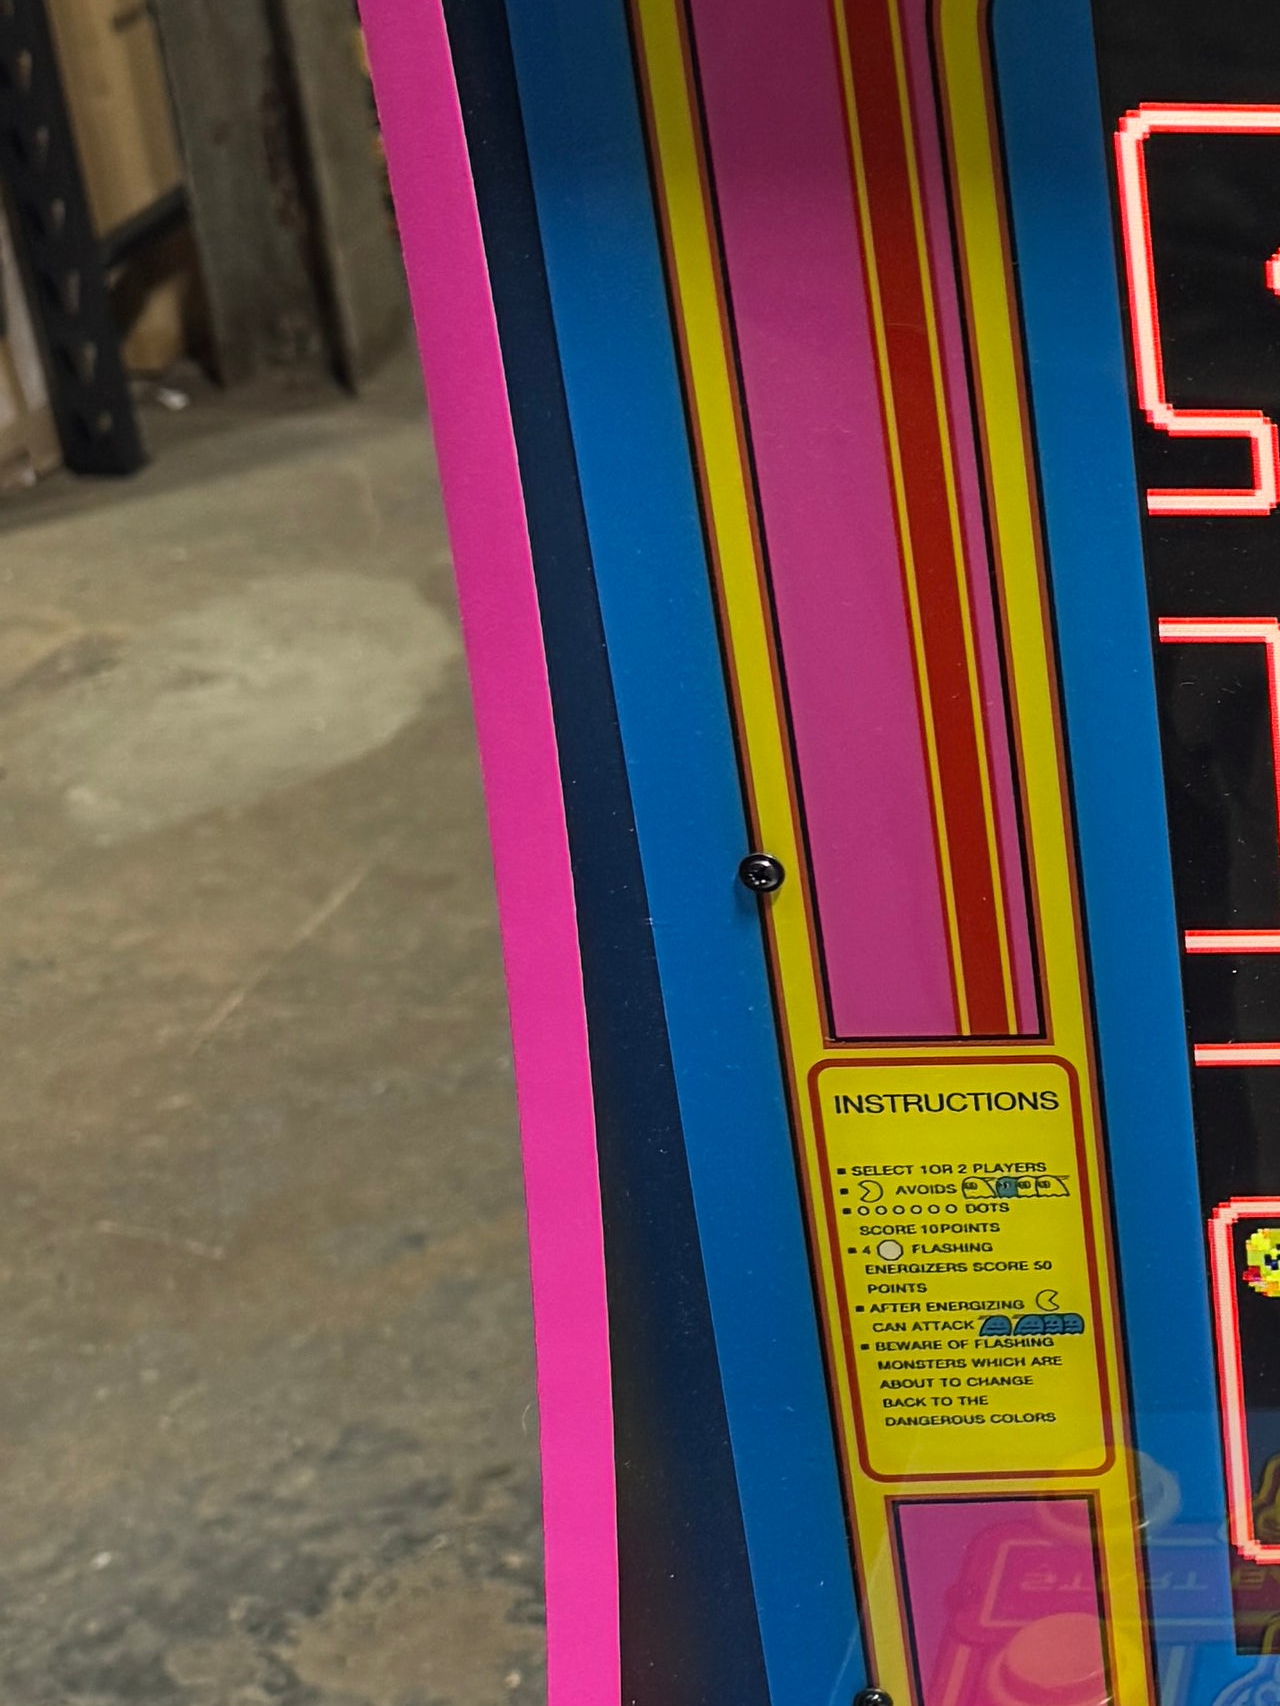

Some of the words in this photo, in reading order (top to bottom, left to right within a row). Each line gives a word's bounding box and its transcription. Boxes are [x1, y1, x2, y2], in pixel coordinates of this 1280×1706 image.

[834, 1091, 1060, 1114] INSTRUCTIONS
[851, 1165, 914, 1176] SELECT
[958, 1163, 966, 1174] 2
[973, 1162, 1047, 1173] PLAYERS
[895, 1183, 957, 1195] AVOIDS
[965, 1203, 1010, 1214] DOTS
[860, 1224, 916, 1236] SCORE
[862, 1245, 871, 1255] 4
[911, 1242, 993, 1254] FLASHING
[865, 1262, 967, 1274] ENERGIZERS
[973, 1261, 1029, 1272] SCORE
[1034, 1260, 1052, 1271] 50
[868, 1283, 927, 1294] POINTS
[870, 1303, 920, 1313] AFTER
[926, 1300, 1025, 1312] ENERGIZING
[872, 1322, 906, 1333] CAN
[912, 1320, 975, 1331] ATTACK
[875, 1340, 942, 1352] BEWARE
[948, 1340, 969, 1349] OF
[975, 1337, 1055, 1349] FLASHING
[877, 1359, 967, 1370] MONSTERS
[972, 1357, 1026, 1368] WHICH
[1031, 1356, 1063, 1367] ARE
[880, 1378, 934, 1389] ABOUT
[940, 1377, 961, 1387] TO
[966, 1376, 1033, 1386] CHANGE
[883, 1397, 927, 1409] BACK
[932, 1397, 952, 1406] TO
[957, 1395, 989, 1406] THE
[885, 1414, 985, 1427] DANGEROUS
[990, 1412, 1057, 1424] COLORS
